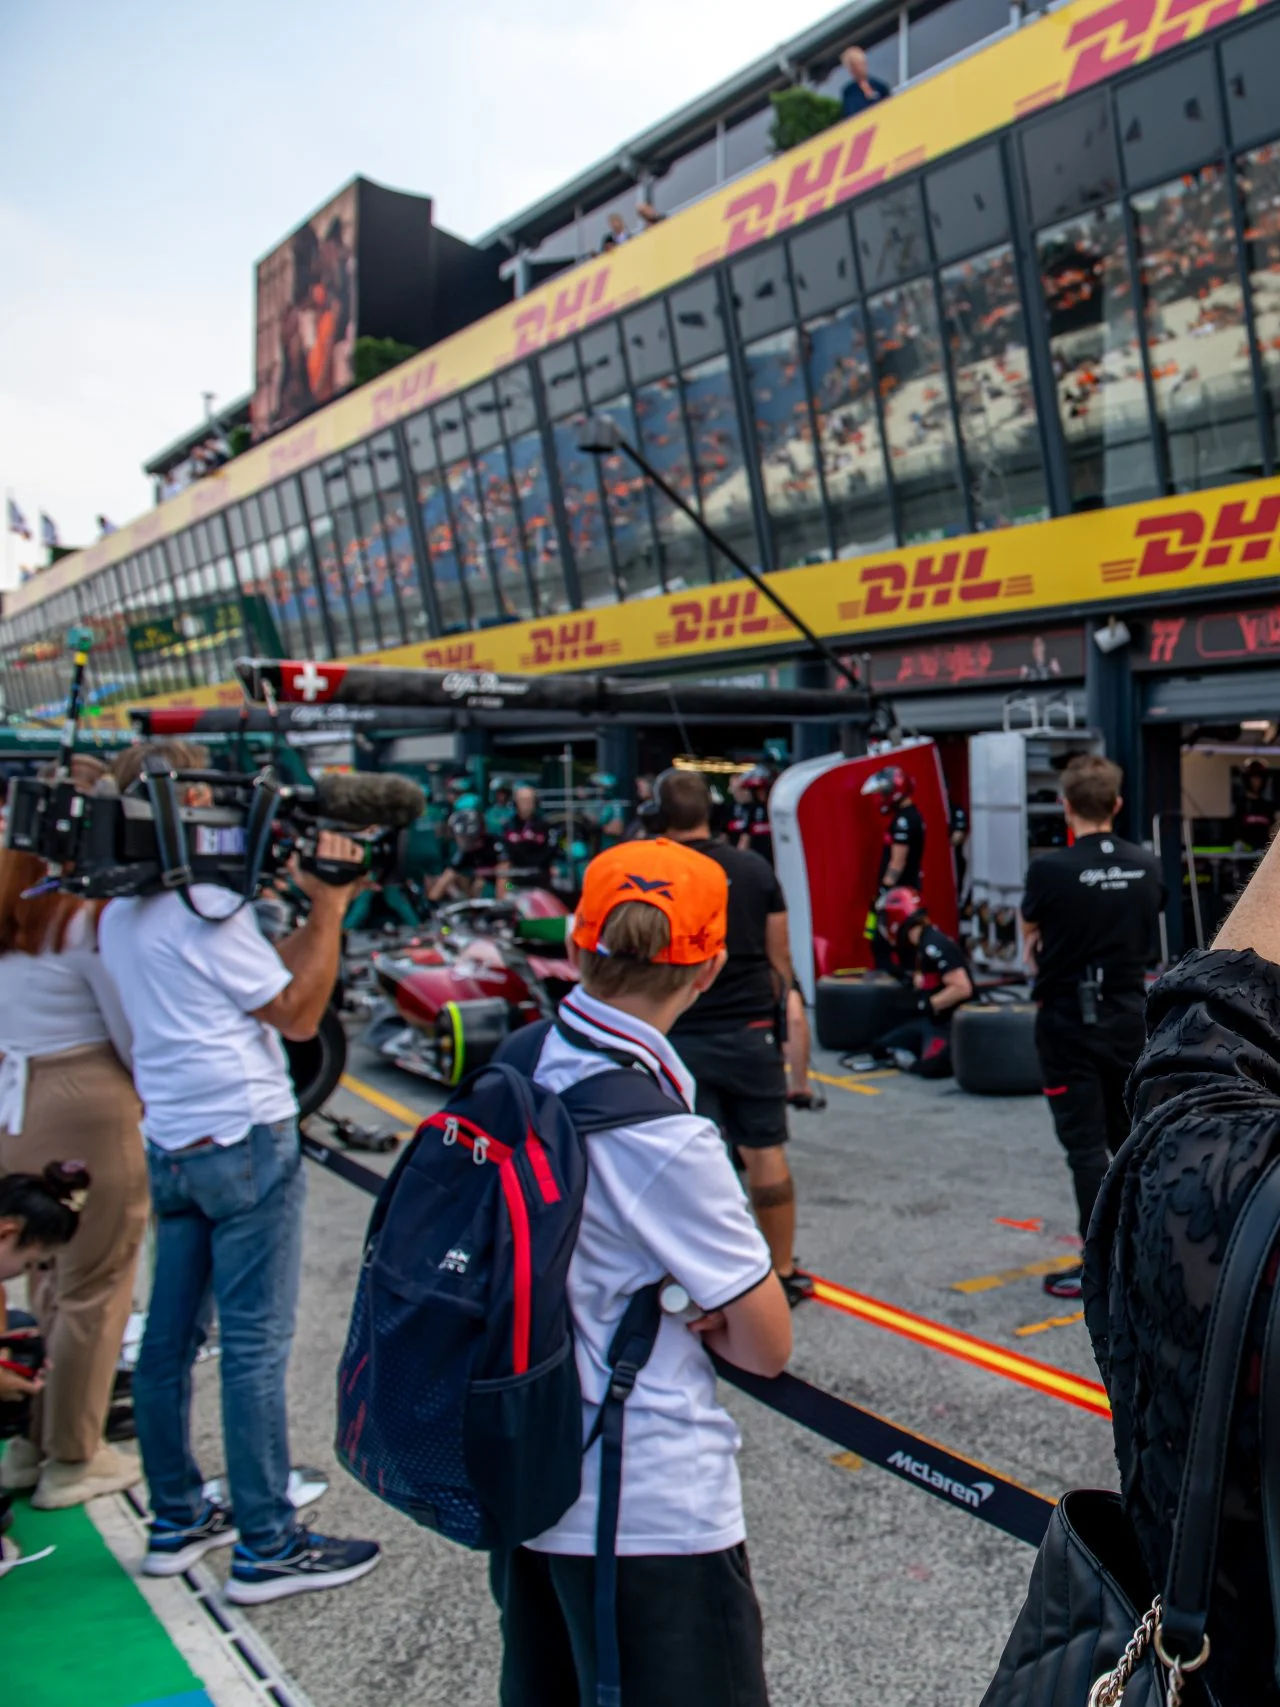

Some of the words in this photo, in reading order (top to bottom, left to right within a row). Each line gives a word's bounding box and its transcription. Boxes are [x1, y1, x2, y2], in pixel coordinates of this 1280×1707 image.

[721, 125, 888, 255] DHL
[859, 548, 1002, 615] DHL
[529, 620, 604, 664] DHL
[670, 592, 769, 644] DHL
[1150, 618, 1186, 663] 77
[887, 1451, 980, 1508] McLaren
